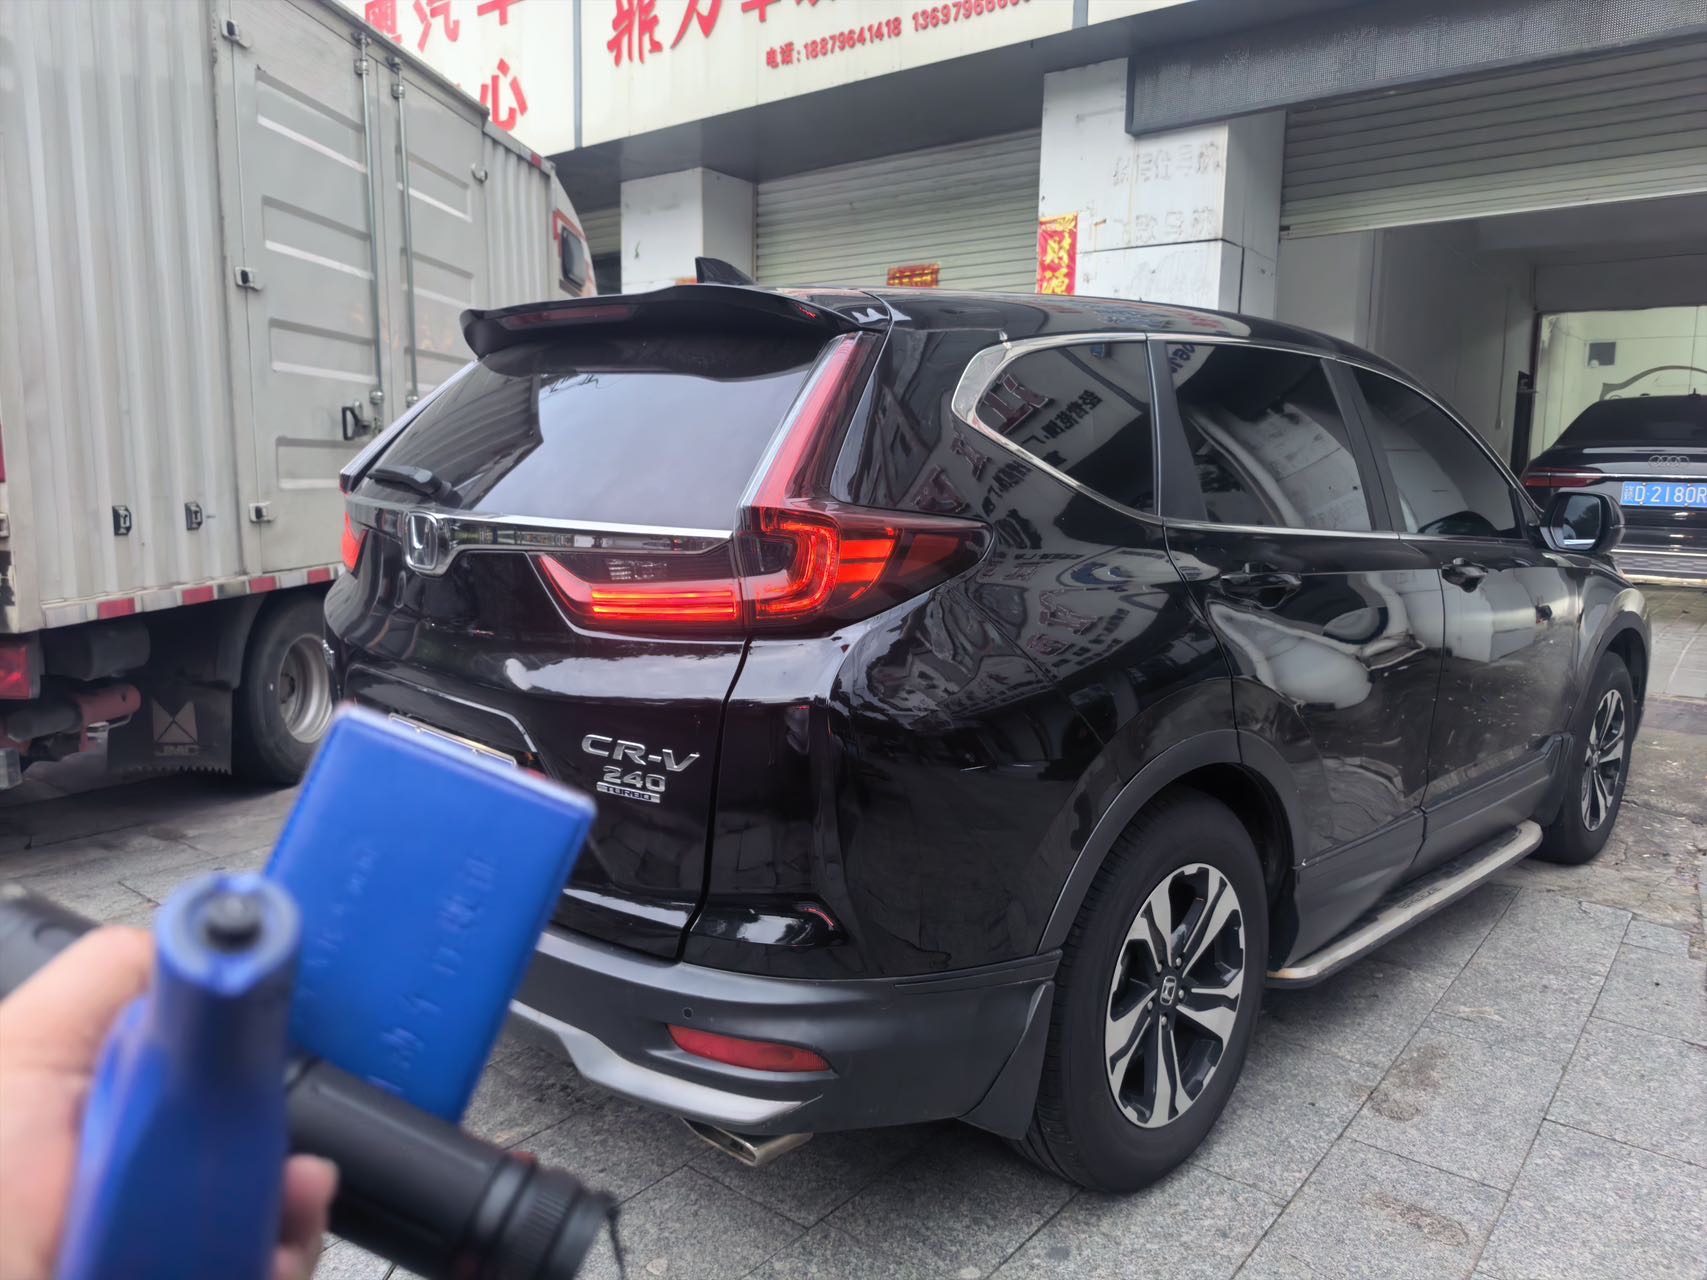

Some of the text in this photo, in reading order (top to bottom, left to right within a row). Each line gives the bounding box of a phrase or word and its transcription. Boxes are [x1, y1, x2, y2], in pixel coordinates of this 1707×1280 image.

[480, 58, 528, 131] 心
[581, 734, 700, 772] CR-V
[602, 765, 666, 792] 240
[603, 784, 654, 802] TURBO
